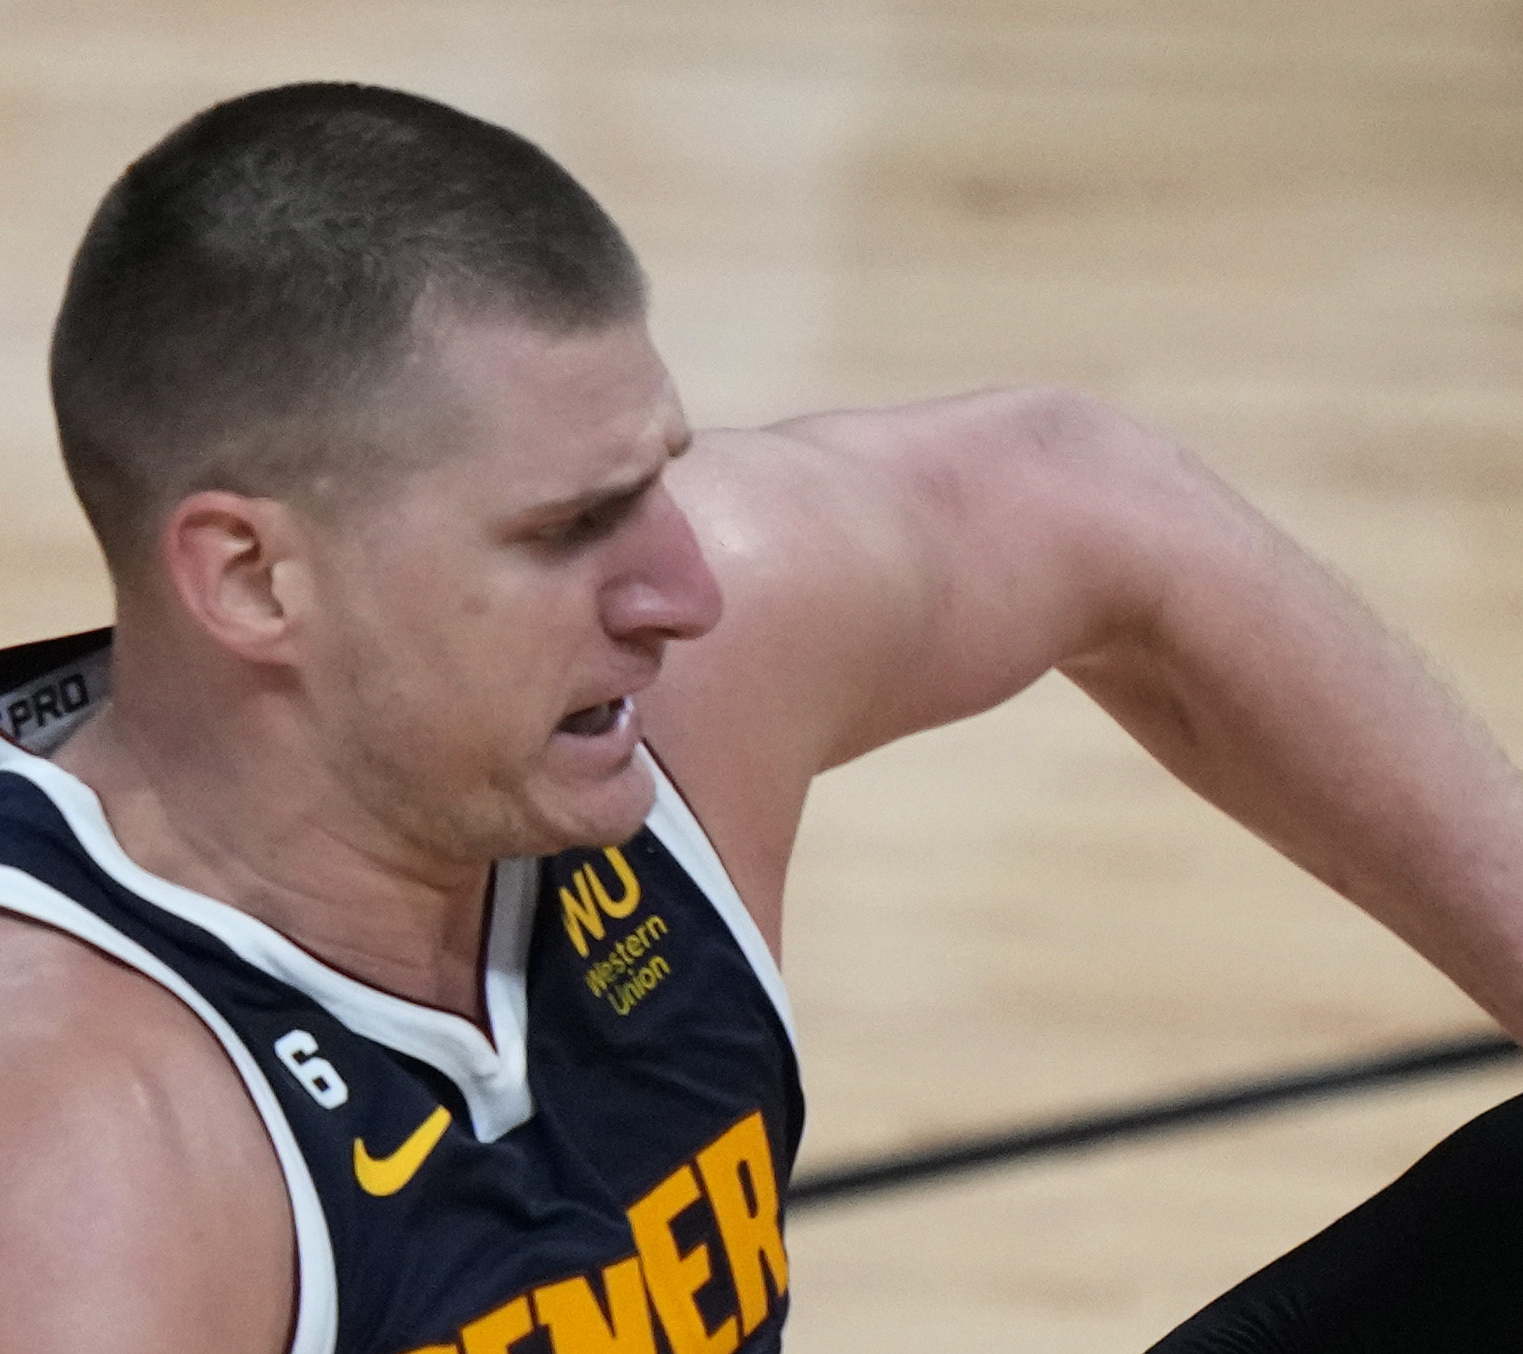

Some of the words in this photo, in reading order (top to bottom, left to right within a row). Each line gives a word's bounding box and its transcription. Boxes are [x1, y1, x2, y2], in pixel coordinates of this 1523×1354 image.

[8, 673, 89, 741] PRO
[586, 915, 668, 998] Western
[607, 955, 671, 1016] Union
[274, 1029, 349, 1111] 6
